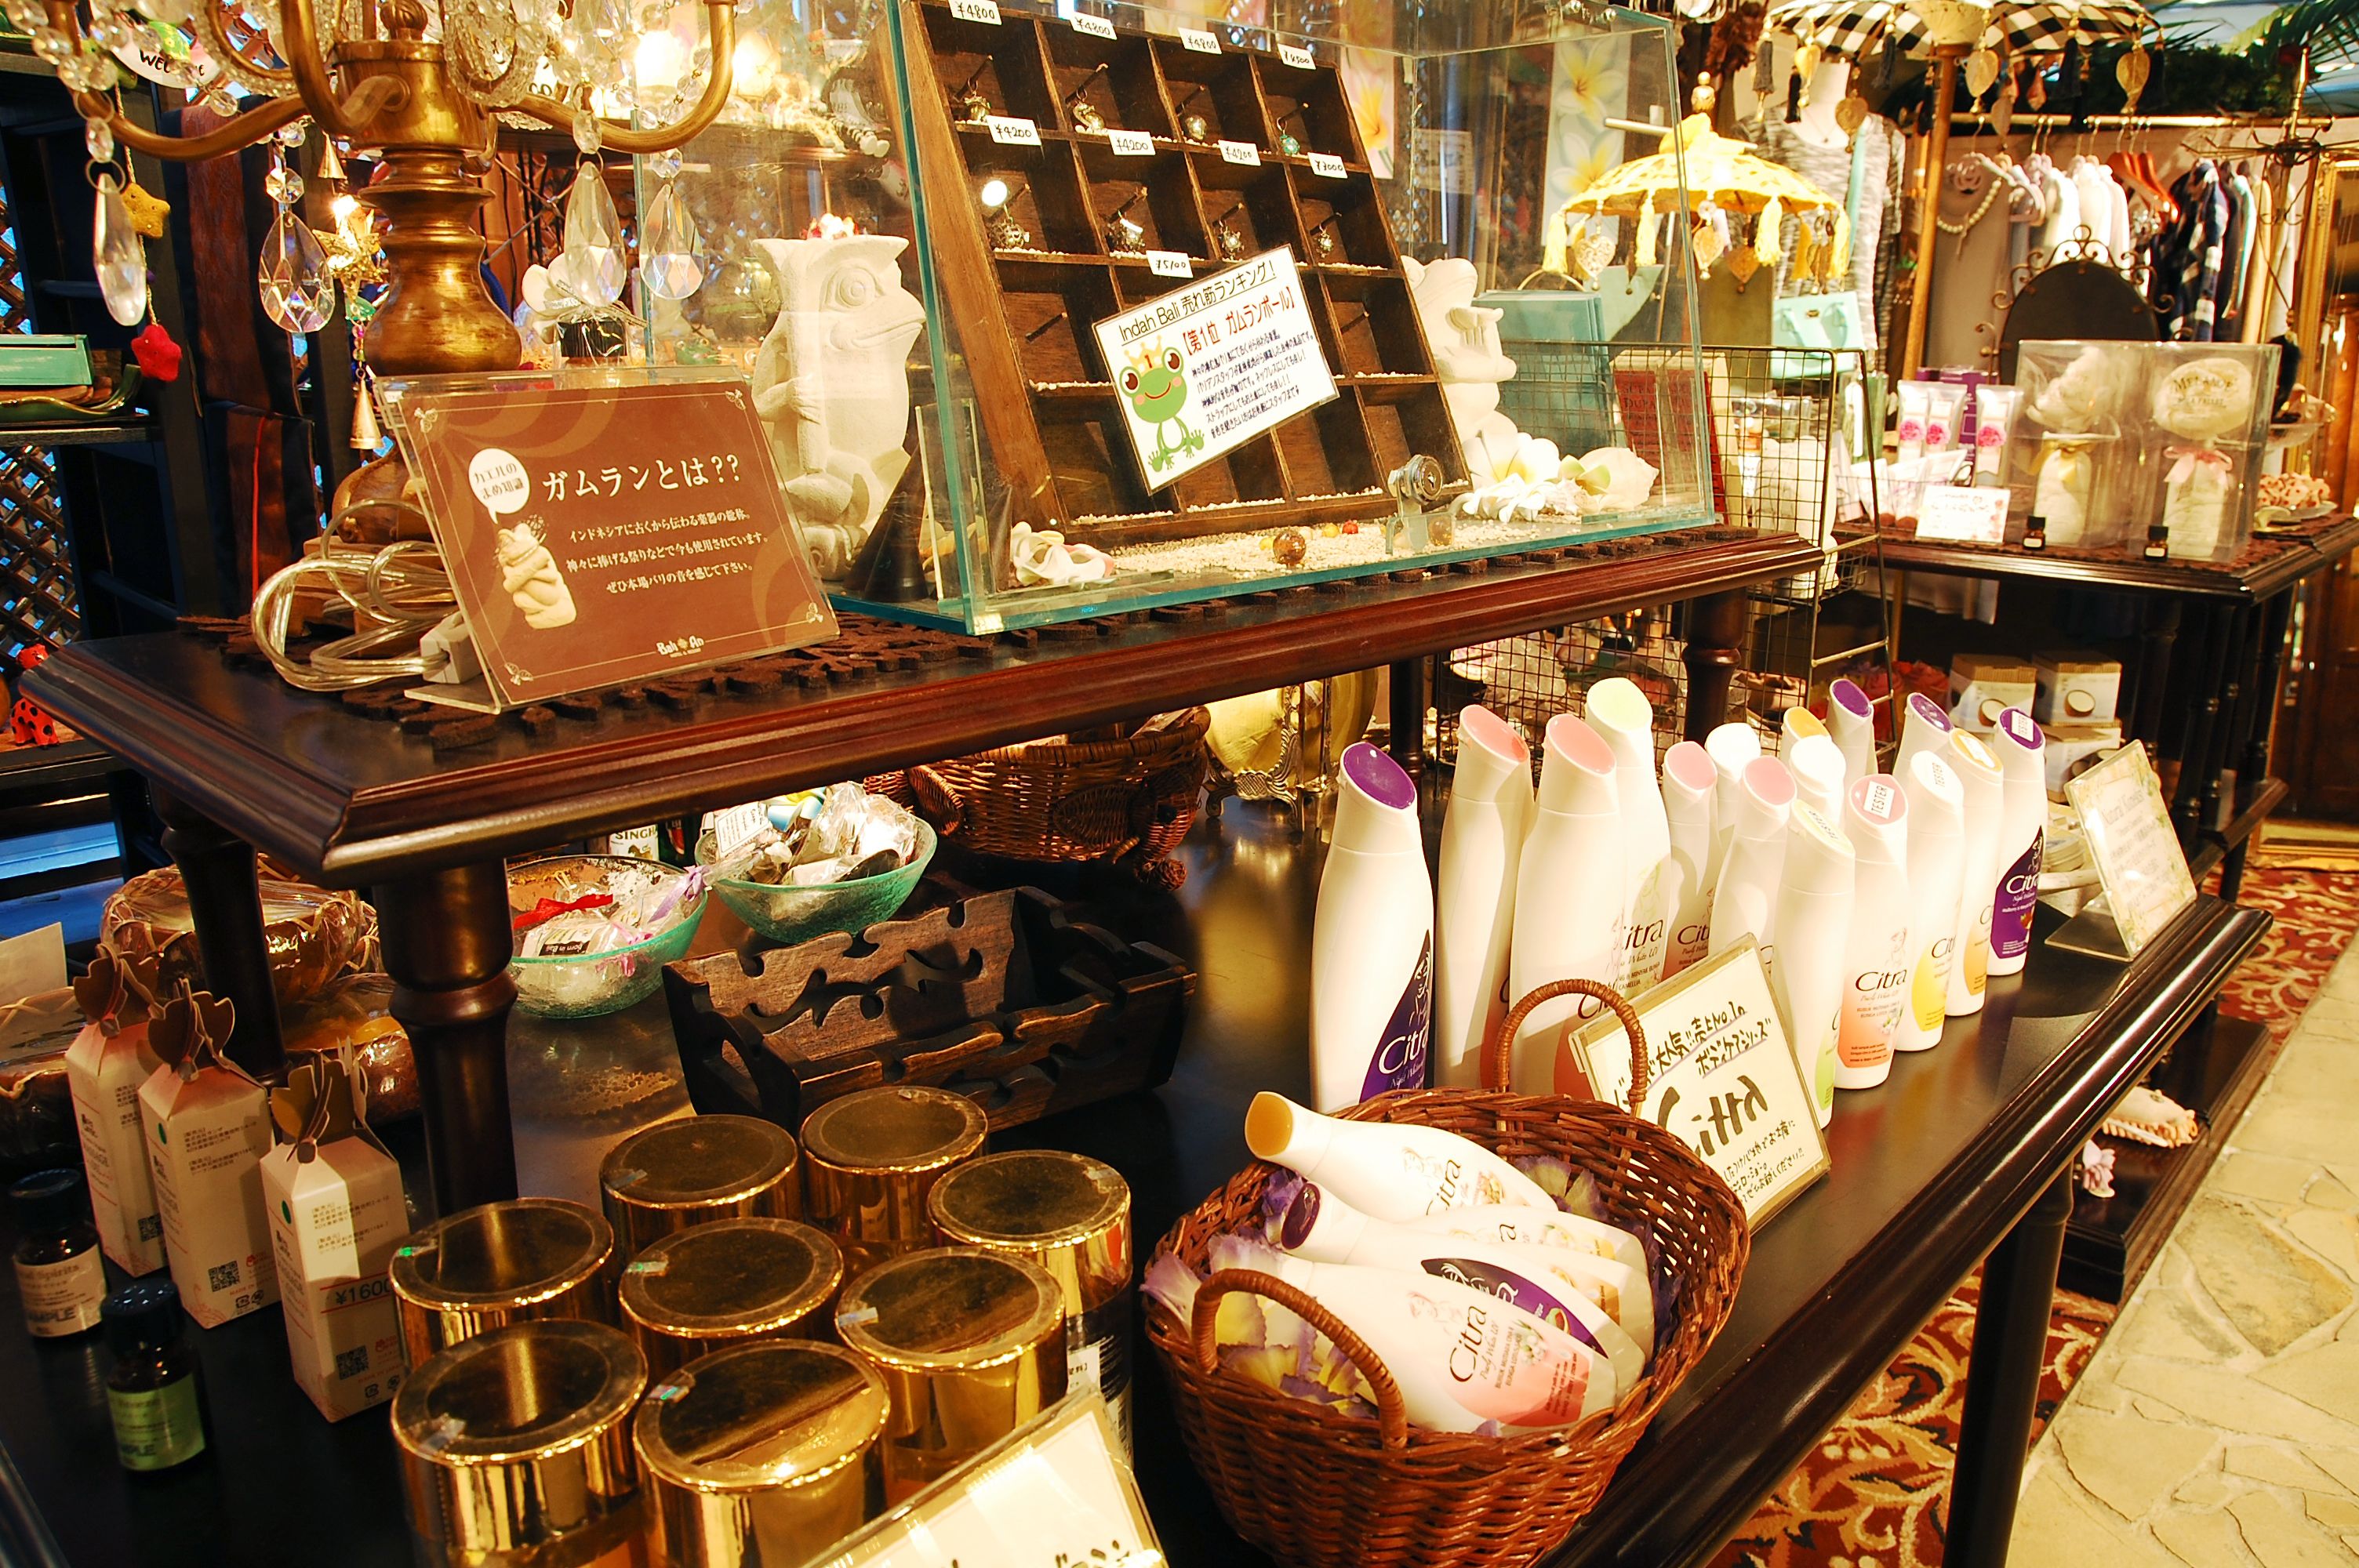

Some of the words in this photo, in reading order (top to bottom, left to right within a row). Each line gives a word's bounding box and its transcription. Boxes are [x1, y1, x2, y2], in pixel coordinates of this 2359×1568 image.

[957, 1, 995, 20] ¥4800
[994, 123, 1032, 140] ¥4200
[1115, 136, 1149, 152] ¥4200
[1119, 315, 1156, 343] Indah
[1156, 301, 1181, 327] Bali
[1144, 354, 1153, 368] 1
[474, 462, 518, 485] カエルの
[1871, 785, 1888, 814] TESTER
[1623, 919, 1663, 950] itra
[1855, 969, 1907, 992] Citra
[1449, 1305, 1487, 1382] Citra
